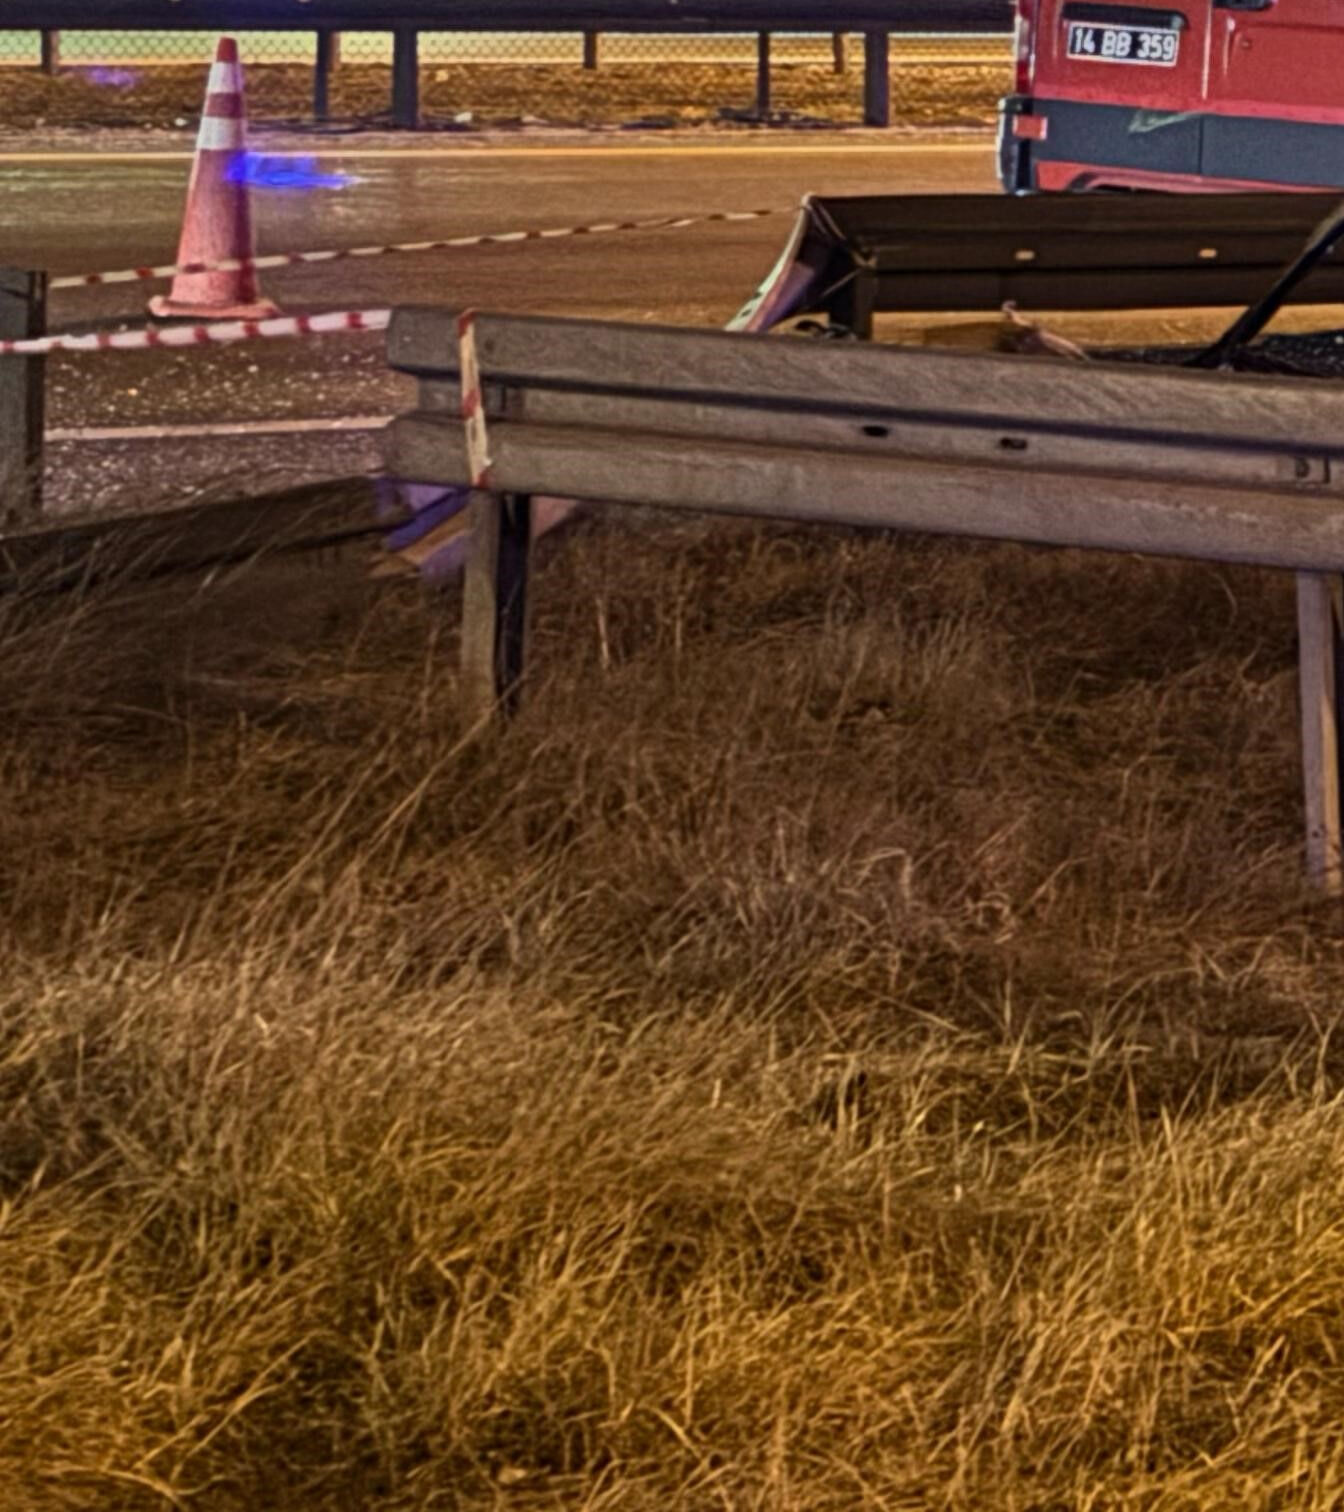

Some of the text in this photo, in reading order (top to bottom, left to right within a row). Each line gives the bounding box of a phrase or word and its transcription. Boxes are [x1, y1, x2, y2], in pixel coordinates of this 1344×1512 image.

[1075, 28, 1175, 60] 14 BB 359
